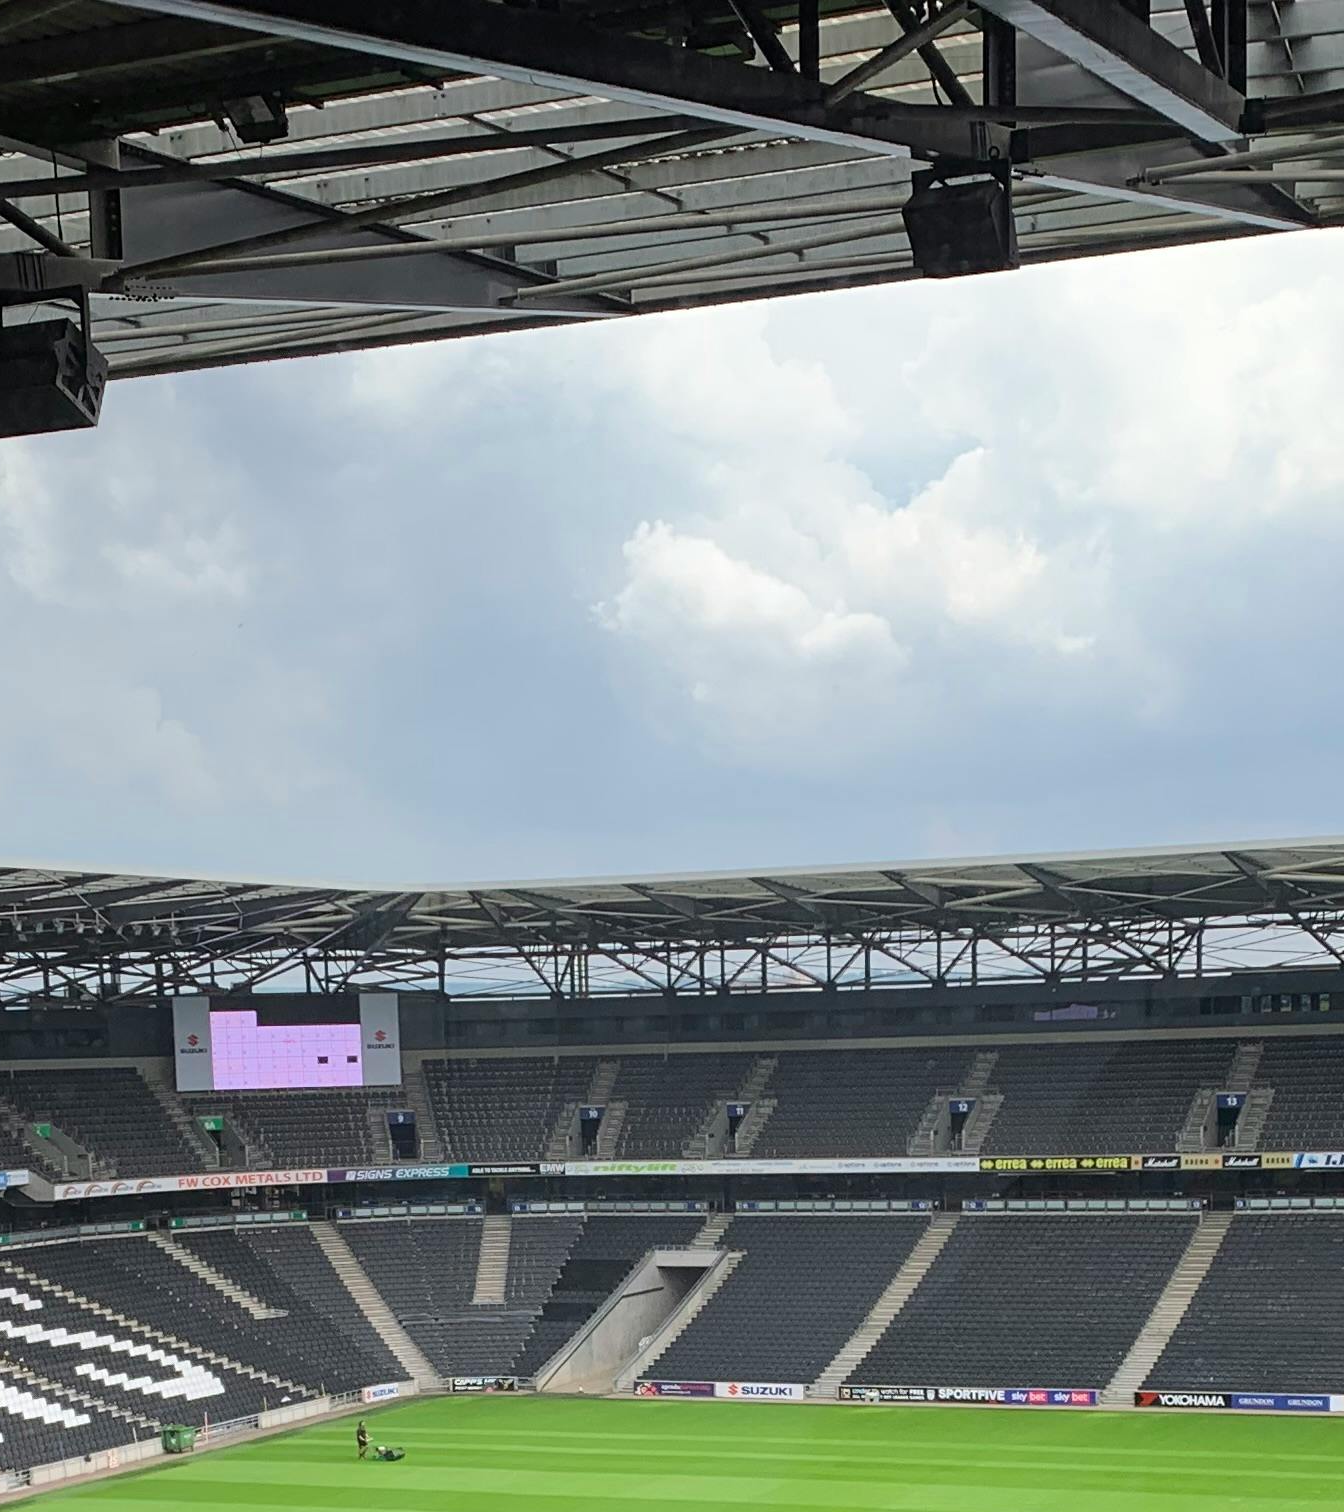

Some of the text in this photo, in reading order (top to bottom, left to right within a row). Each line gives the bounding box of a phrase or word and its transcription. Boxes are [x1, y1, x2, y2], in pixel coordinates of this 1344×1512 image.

[356, 1167, 448, 1180] SIGNS EXPRESS
[178, 1172, 323, 1188] FW COX METALS LTD
[741, 1386, 792, 1397] SUZUKI
[938, 1389, 1005, 1401] SPORTFIVE
[1011, 1392, 1045, 1402] sky bet
[1054, 1392, 1088, 1403] sky bet
[1158, 1393, 1225, 1407] YOKOHAMA
